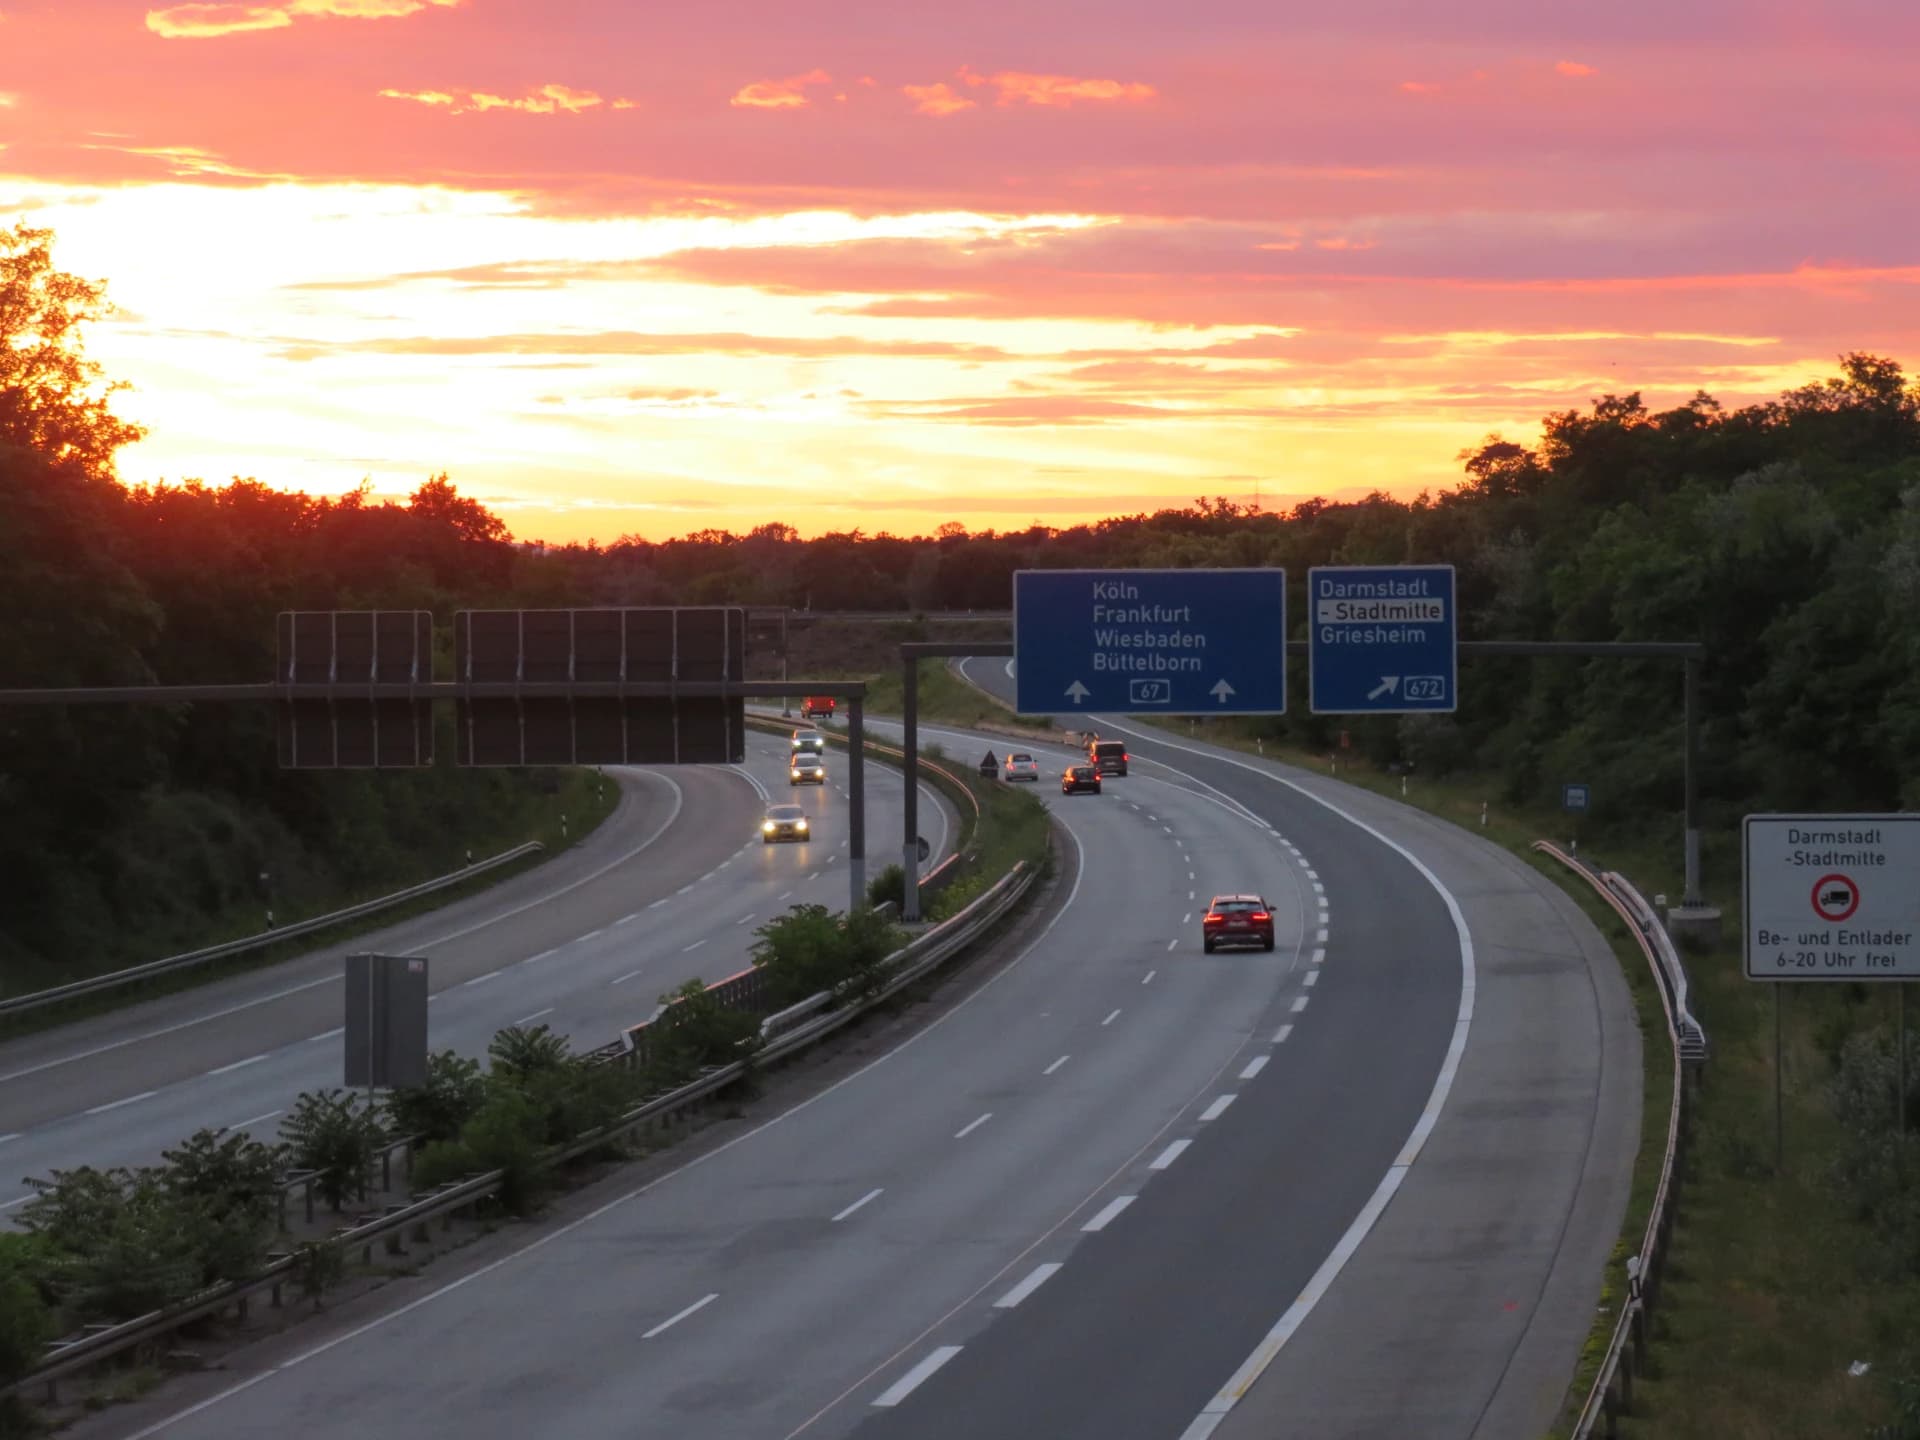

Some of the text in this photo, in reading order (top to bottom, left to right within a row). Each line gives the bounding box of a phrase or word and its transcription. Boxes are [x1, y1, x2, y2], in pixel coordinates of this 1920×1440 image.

[1093, 581, 1139, 600] Köln
[1320, 578, 1428, 597] Darmstadt
[1093, 605, 1190, 623] Frankfurt
[1095, 629, 1206, 648] Wiesbaden
[1321, 625, 1425, 644] Griesheim
[1093, 653, 1202, 671] Büttelborn
[1140, 684, 1160, 698] 67
[1410, 681, 1439, 695] 672
[1788, 828, 1881, 844] Darmstadt
[1758, 930, 1912, 945] Be- und Entlader
[1777, 952, 1896, 967] 6-20 Uhr frei
